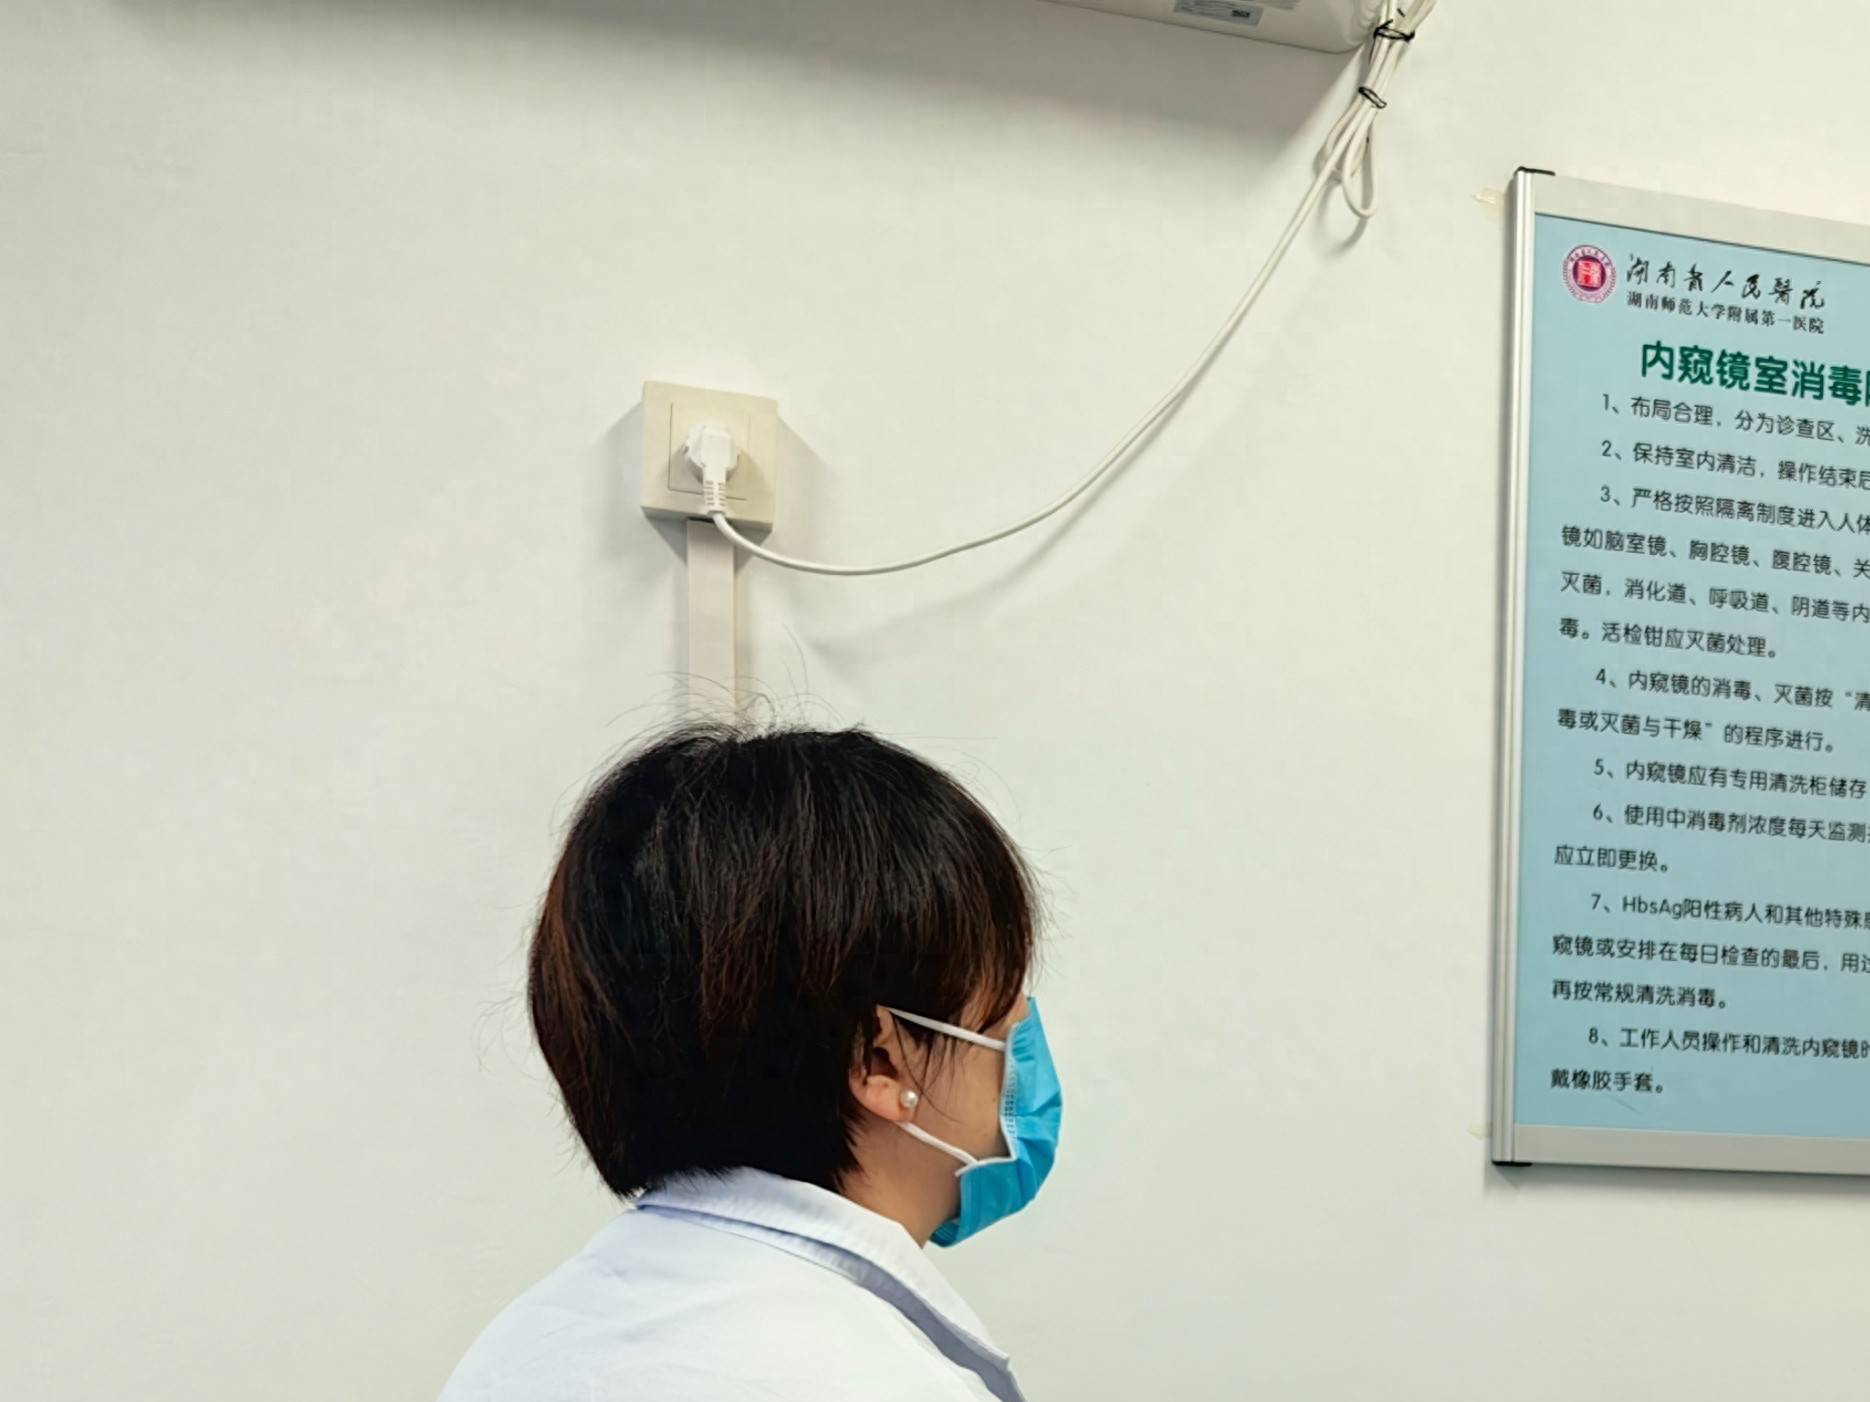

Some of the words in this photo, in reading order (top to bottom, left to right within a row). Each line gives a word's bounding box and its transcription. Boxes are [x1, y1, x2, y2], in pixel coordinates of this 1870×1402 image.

[1625, 290, 1826, 336] 湖南师范大学附属第一医院
[1557, 616, 1778, 659] 毒。活检钳应灭菌处理。
[1552, 843, 1670, 874] 应立即更换。
[1550, 978, 1728, 1010] 再按常规清洗消毒。
[1549, 1067, 1665, 1095] 戴橡胶手套。
